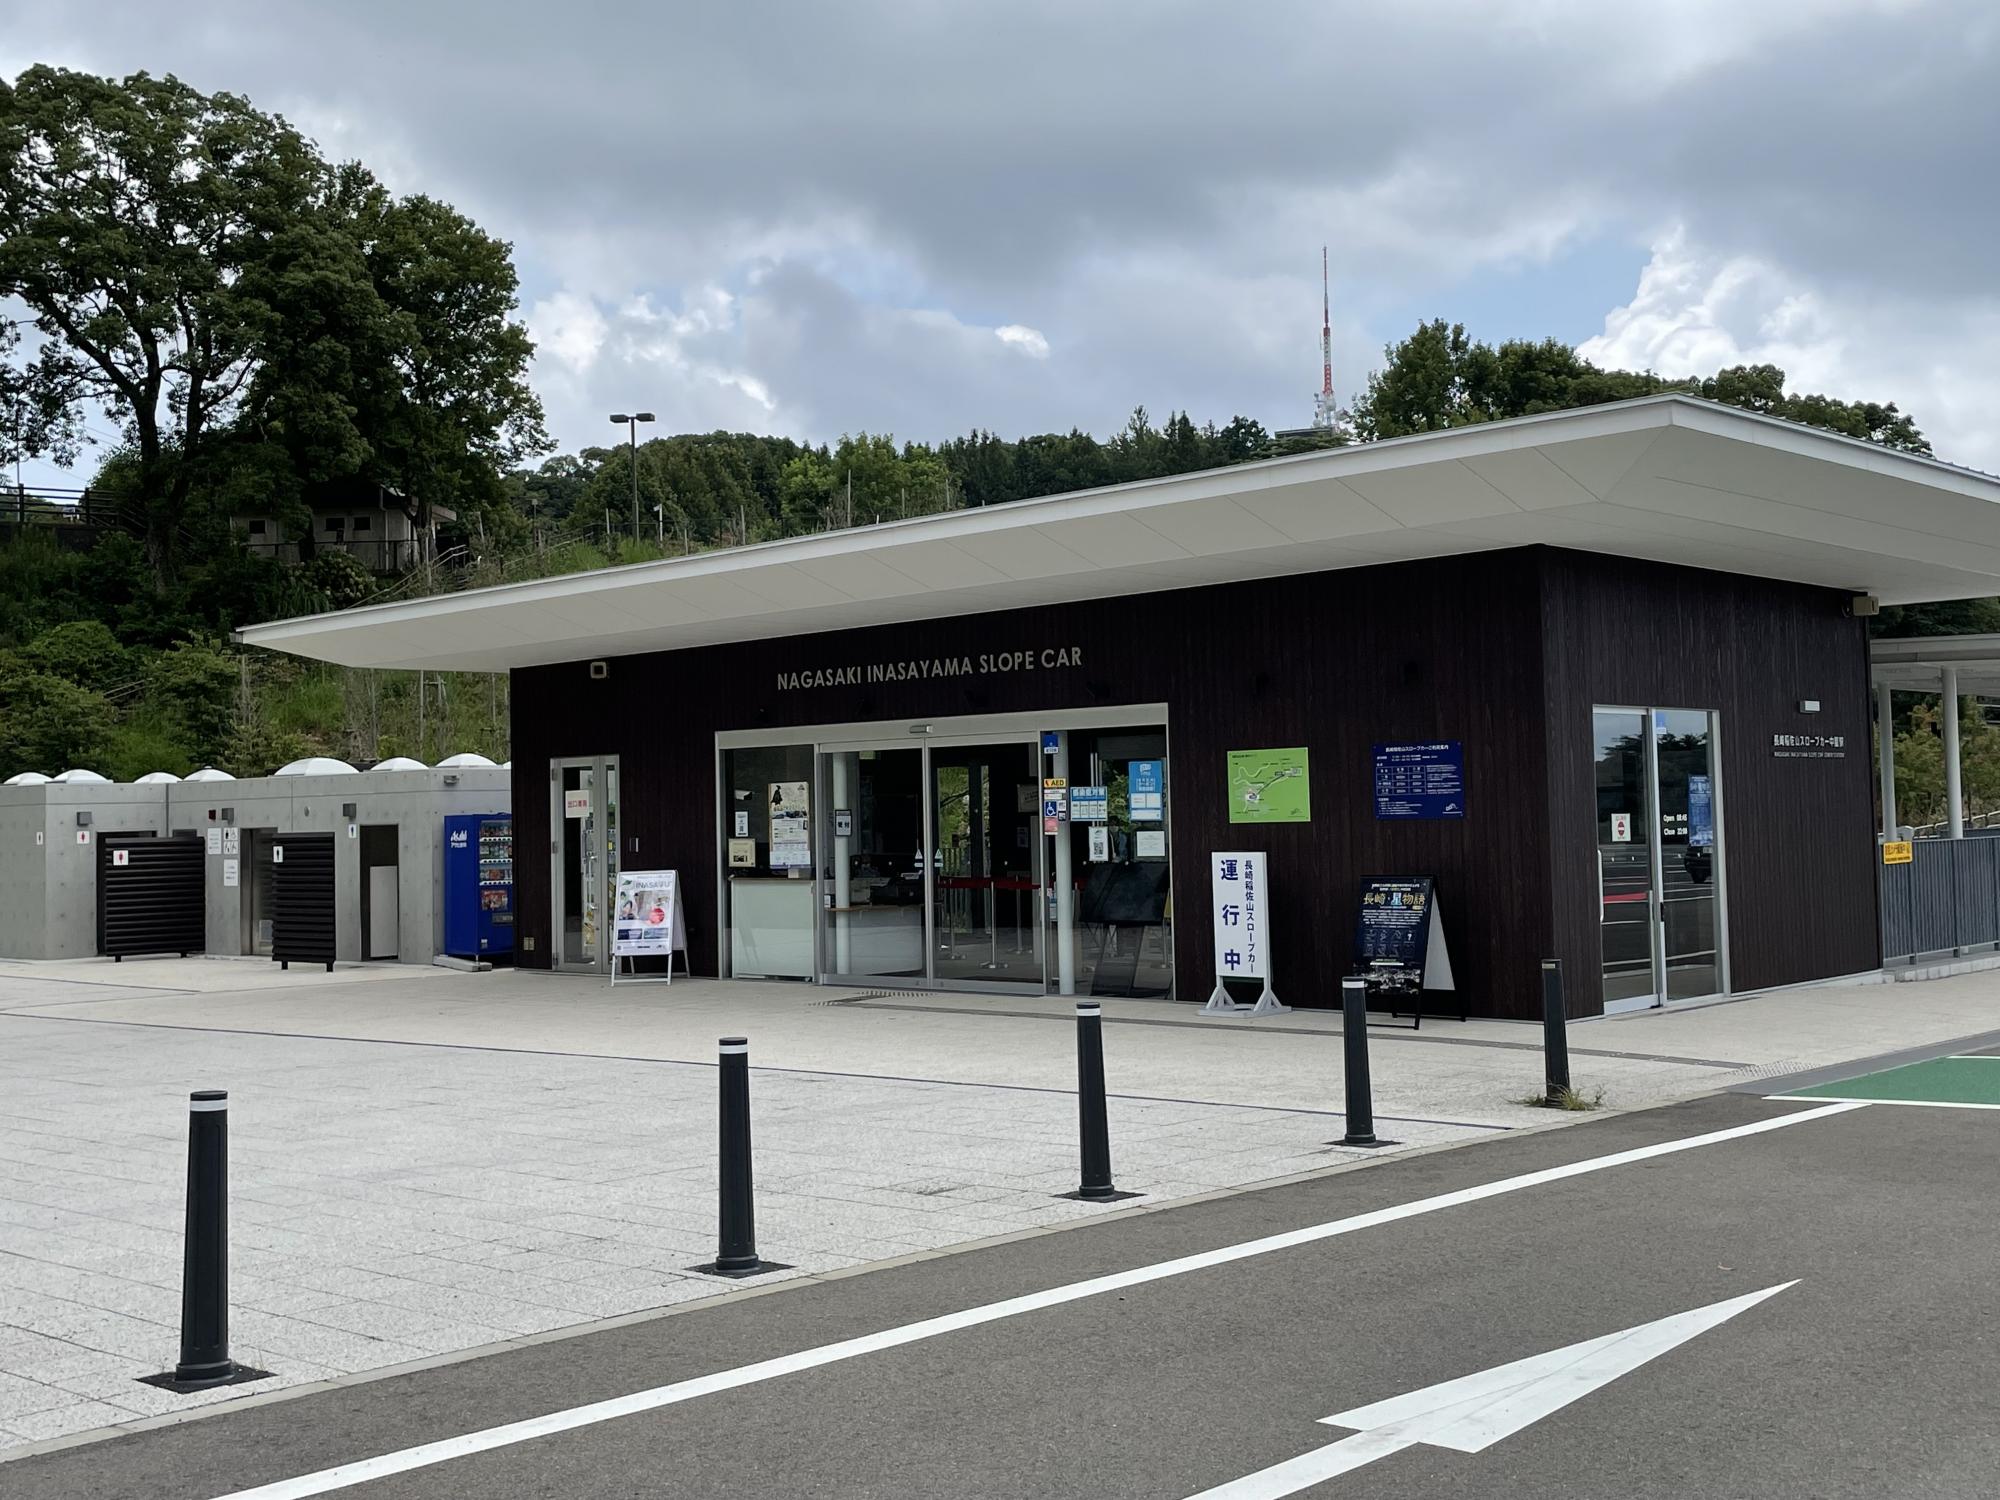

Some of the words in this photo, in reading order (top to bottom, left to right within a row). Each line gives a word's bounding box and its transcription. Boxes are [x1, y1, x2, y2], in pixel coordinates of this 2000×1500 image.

[777, 666, 861, 690] NAGASAKI
[867, 656, 973, 682] INASAYAMA
[979, 651, 1035, 673] SLOPE
[1041, 646, 1082, 668] CAR
[450, 830, 468, 842] Asahi
[1221, 859, 1240, 971] 運行中
